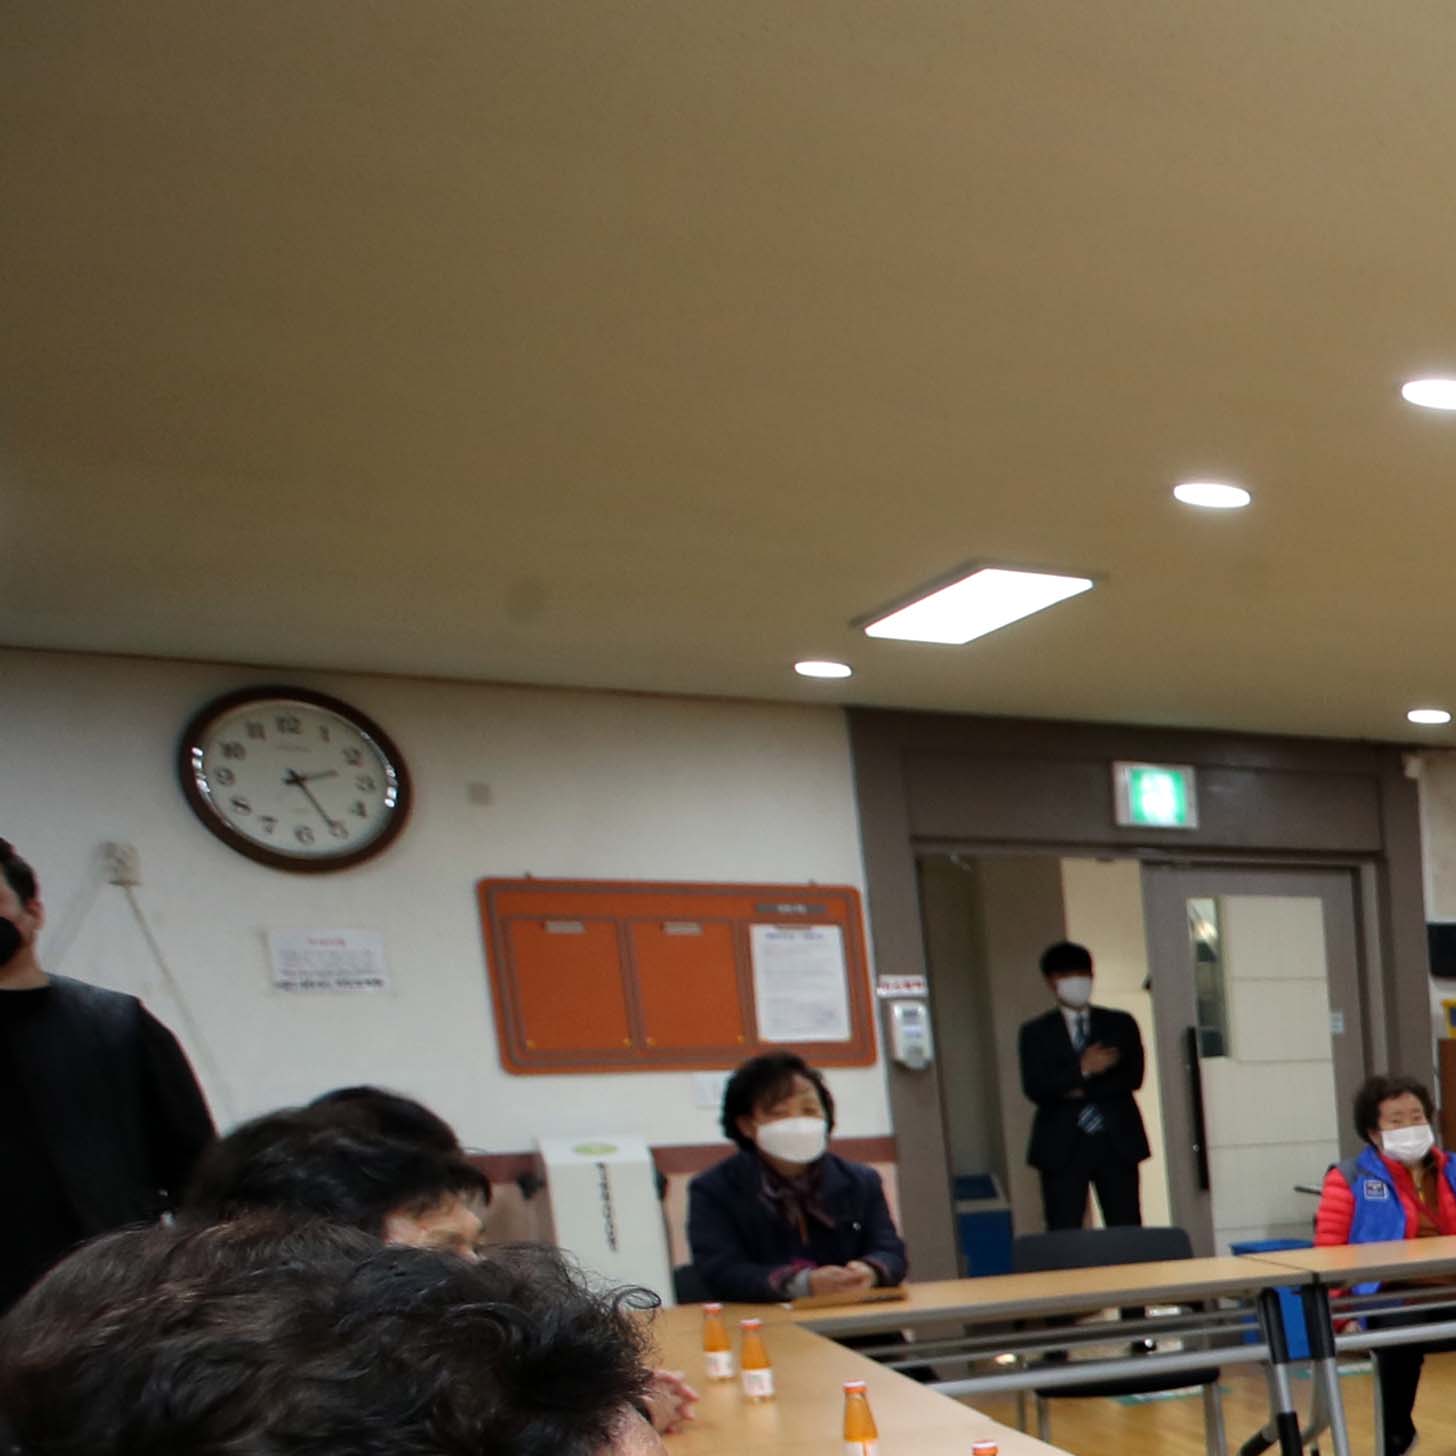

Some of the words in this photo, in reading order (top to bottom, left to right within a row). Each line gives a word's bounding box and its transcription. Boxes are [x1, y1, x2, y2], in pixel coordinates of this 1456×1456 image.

[247, 721, 266, 741] 11
[276, 712, 301, 735] 12
[221, 741, 246, 761] 10
[344, 747, 363, 768] 2
[214, 766, 235, 786] 9
[356, 774, 376, 793] 3
[231, 796, 252, 816] 8
[351, 800, 367, 818] 4
[259, 814, 277, 834] 7
[294, 824, 315, 845] 6
